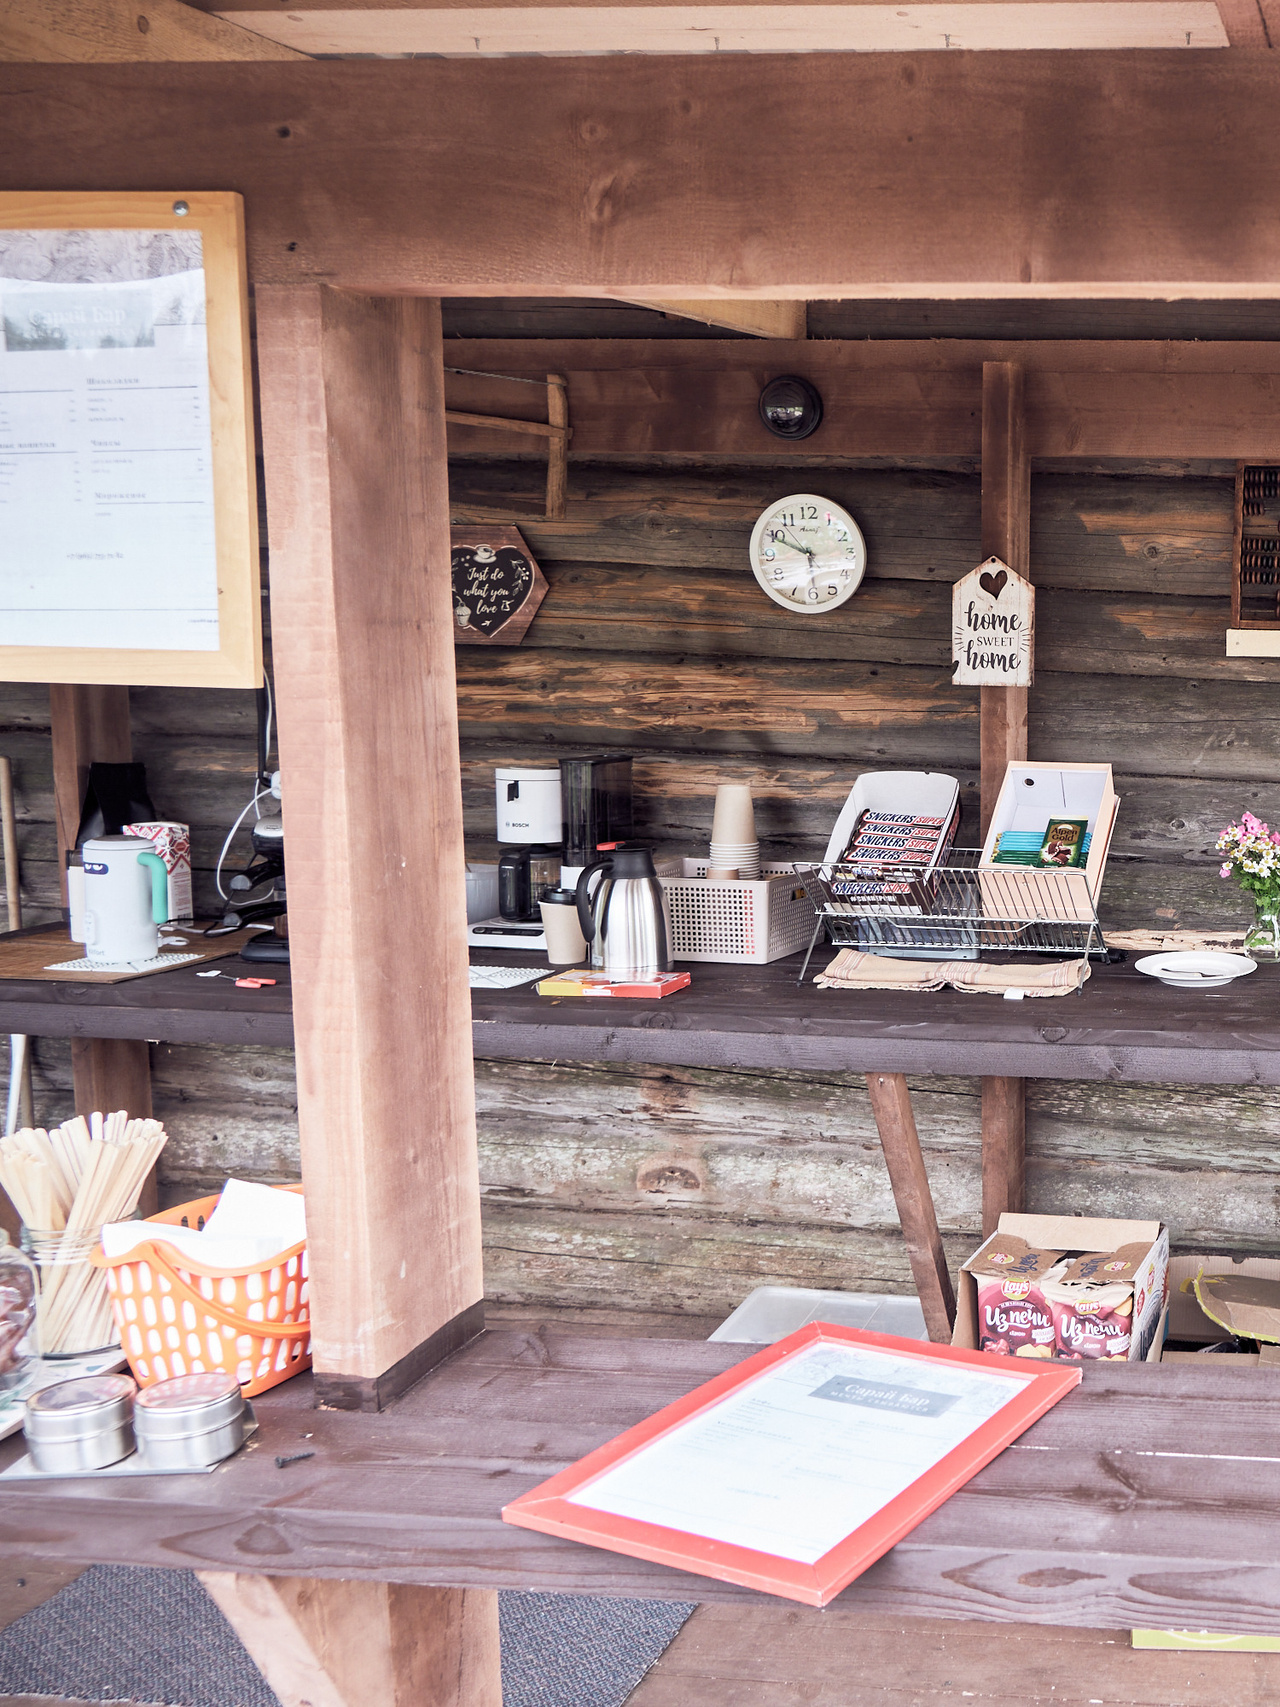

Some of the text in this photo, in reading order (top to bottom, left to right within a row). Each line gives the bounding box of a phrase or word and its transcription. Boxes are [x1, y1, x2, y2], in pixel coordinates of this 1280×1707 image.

[782, 513, 795, 526] 11
[800, 506, 818, 520] 12
[826, 513, 831, 526] 1
[770, 530, 785, 542] 10
[838, 530, 848, 542] 2
[765, 548, 776, 562] 9
[846, 548, 856, 560] 3
[467, 567, 504, 580] Just do
[840, 569, 850, 580] 4
[464, 580, 510, 602] what you
[808, 586, 818, 600] 6
[828, 584, 838, 595] 5
[476, 600, 498, 614] love
[964, 601, 1022, 634] home
[977, 636, 1014, 646] SWEET
[964, 640, 1021, 672] home
[866, 812, 916, 824] SNICKERS
[864, 823, 914, 836] SNICKERS
[1051, 827, 1078, 836] Alpen
[858, 834, 908, 848] SNICKERS
[852, 848, 906, 860] SNICKERS
[832, 882, 886, 894] SNICKERS
[1004, 1280, 1030, 1295] Lay's
[984, 1305, 1010, 1333] Из
[1009, 1309, 1050, 1328] печи
[1060, 1314, 1085, 1346] Из
[1084, 1321, 1124, 1337] печи
[844, 1384, 930, 1406] Сарай Бар
